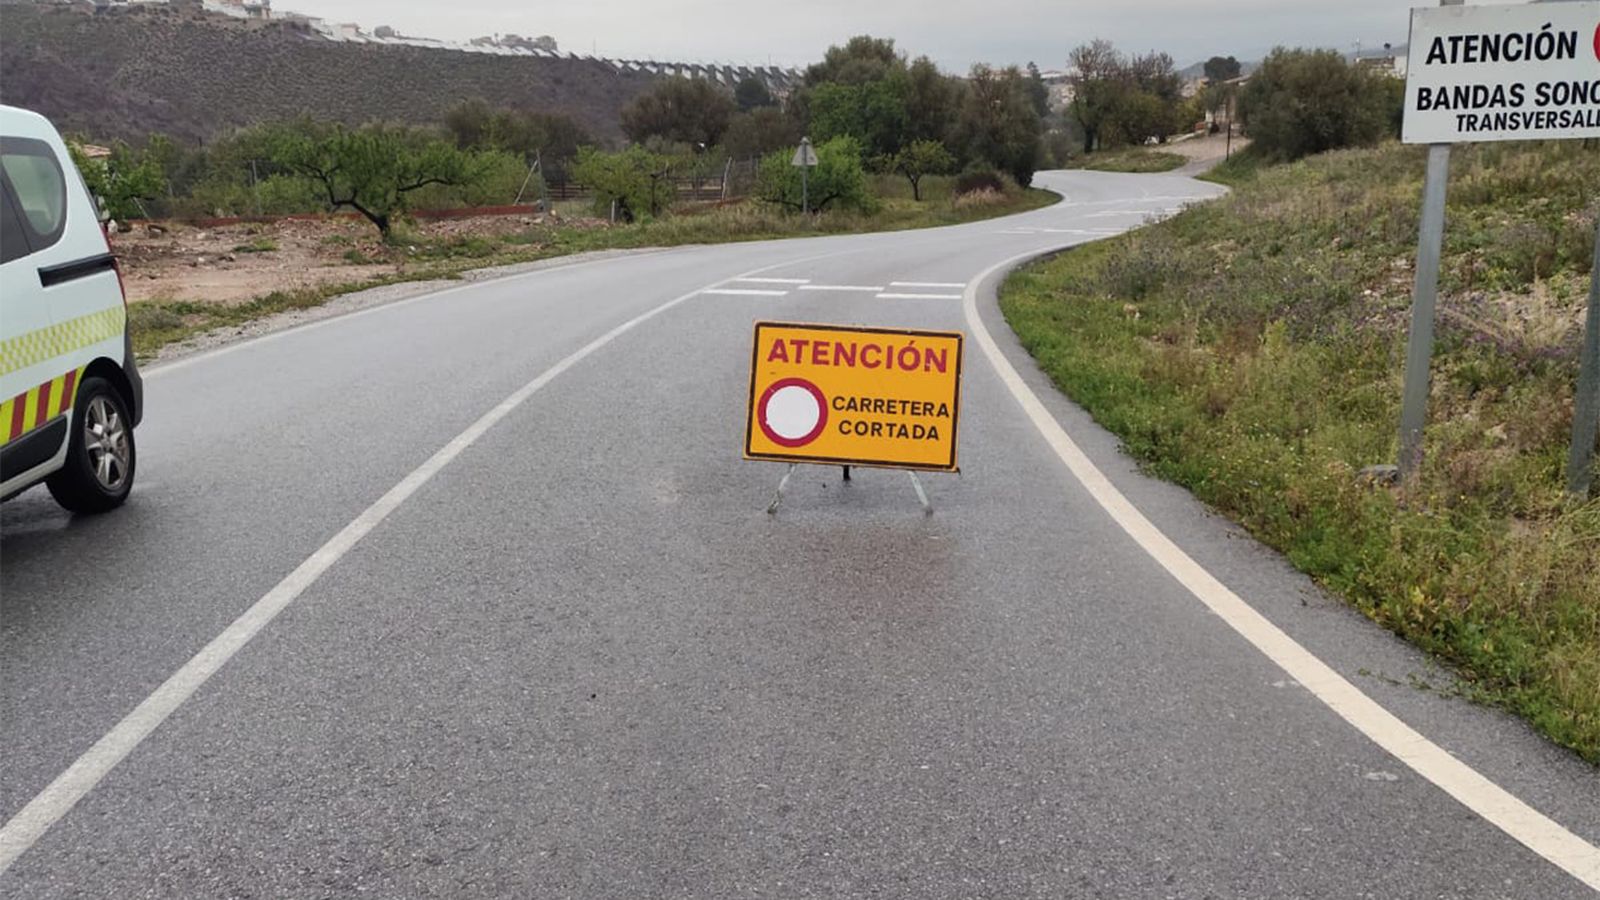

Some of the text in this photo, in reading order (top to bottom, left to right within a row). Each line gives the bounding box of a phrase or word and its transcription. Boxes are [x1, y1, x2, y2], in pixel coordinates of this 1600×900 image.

[1426, 22, 1577, 64] ATENCIÓN
[1417, 83, 1525, 110] BANDAS
[767, 338, 947, 373] ATENCIÓN
[832, 396, 949, 417] CARRETERA
[838, 420, 939, 440] CORTADA
